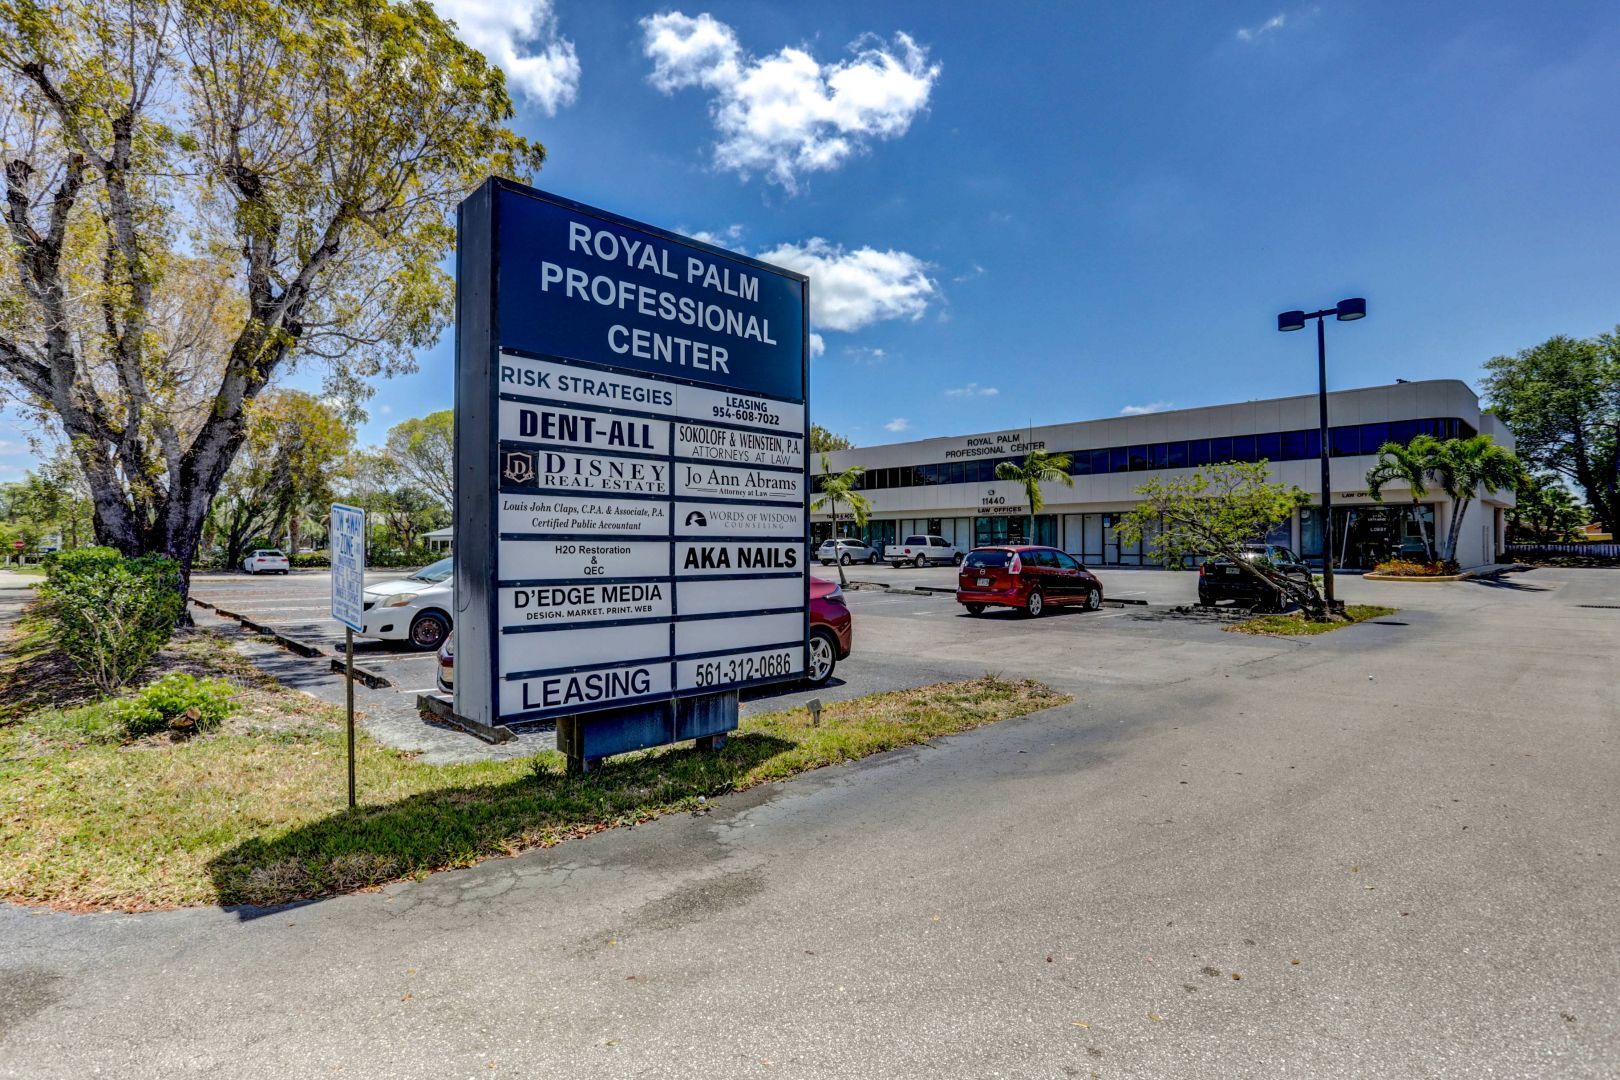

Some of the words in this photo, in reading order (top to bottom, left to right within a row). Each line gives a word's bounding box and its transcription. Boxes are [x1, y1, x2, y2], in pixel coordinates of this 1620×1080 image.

[569, 221, 678, 279] ROYAL
[687, 257, 759, 302] PALM
[541, 261, 777, 345] PROFESSIONAL
[608, 325, 730, 374] CENTER
[501, 365, 551, 389] RISK
[558, 375, 673, 406] STRATEGIES
[726, 396, 767, 412] LEASING
[713, 406, 779, 425] 954-608-7022
[519, 409, 654, 449] DENT-ALL
[680, 425, 726, 446] SOKOLOFF
[730, 432, 736, 447] &
[740, 433, 784, 454] WEINSTEIN,
[787, 439, 801, 455] P.A.
[967, 438, 993, 447] ROYAL
[997, 434, 1020, 444] PALM
[692, 445, 749, 461] ATTORNEYS
[755, 453, 766, 462] AT
[771, 453, 791, 465] LAW
[945, 446, 1005, 459] PROFESSIONAL
[1011, 441, 1045, 453] CENTER
[513, 460, 527, 475] D
[544, 453, 665, 482] DISNEY
[544, 475, 594, 488] REAL
[602, 479, 666, 493] ESTATE
[685, 466, 702, 487] Jo
[707, 468, 740, 486] Ann
[745, 471, 797, 491] Abrams
[719, 487, 746, 497] Attorney
[755, 489, 768, 497] Law
[503, 501, 528, 512] Louis
[530, 502, 551, 512] John
[554, 503, 579, 515] Claps,
[581, 504, 604, 515] C.P.A.
[606, 506, 613, 515] &
[614, 506, 650, 518] Associate,
[651, 508, 664, 518] P.A.
[709, 511, 744, 522] WORDS
[747, 513, 758, 522] OF
[760, 513, 797, 524] WISDOM
[532, 518, 569, 530] Certified
[571, 518, 597, 530] Public
[598, 521, 641, 531] Accountant
[724, 522, 784, 530] COUNSELING
[555, 545, 576, 554] H2O
[579, 545, 631, 555] Restoration
[684, 547, 731, 569] AKA
[737, 547, 797, 569] NAILS
[590, 556, 598, 565] &
[583, 566, 605, 576] QEC
[514, 586, 596, 609] D'EDGE
[601, 584, 663, 603] MEDIA
[526, 610, 564, 621] DESIGN.
[567, 608, 605, 618] MARKET.
[606, 606, 633, 615] PRINT.
[634, 604, 652, 613] WEB
[695, 652, 791, 688] 561-312-0686
[522, 668, 650, 710] LEASING
